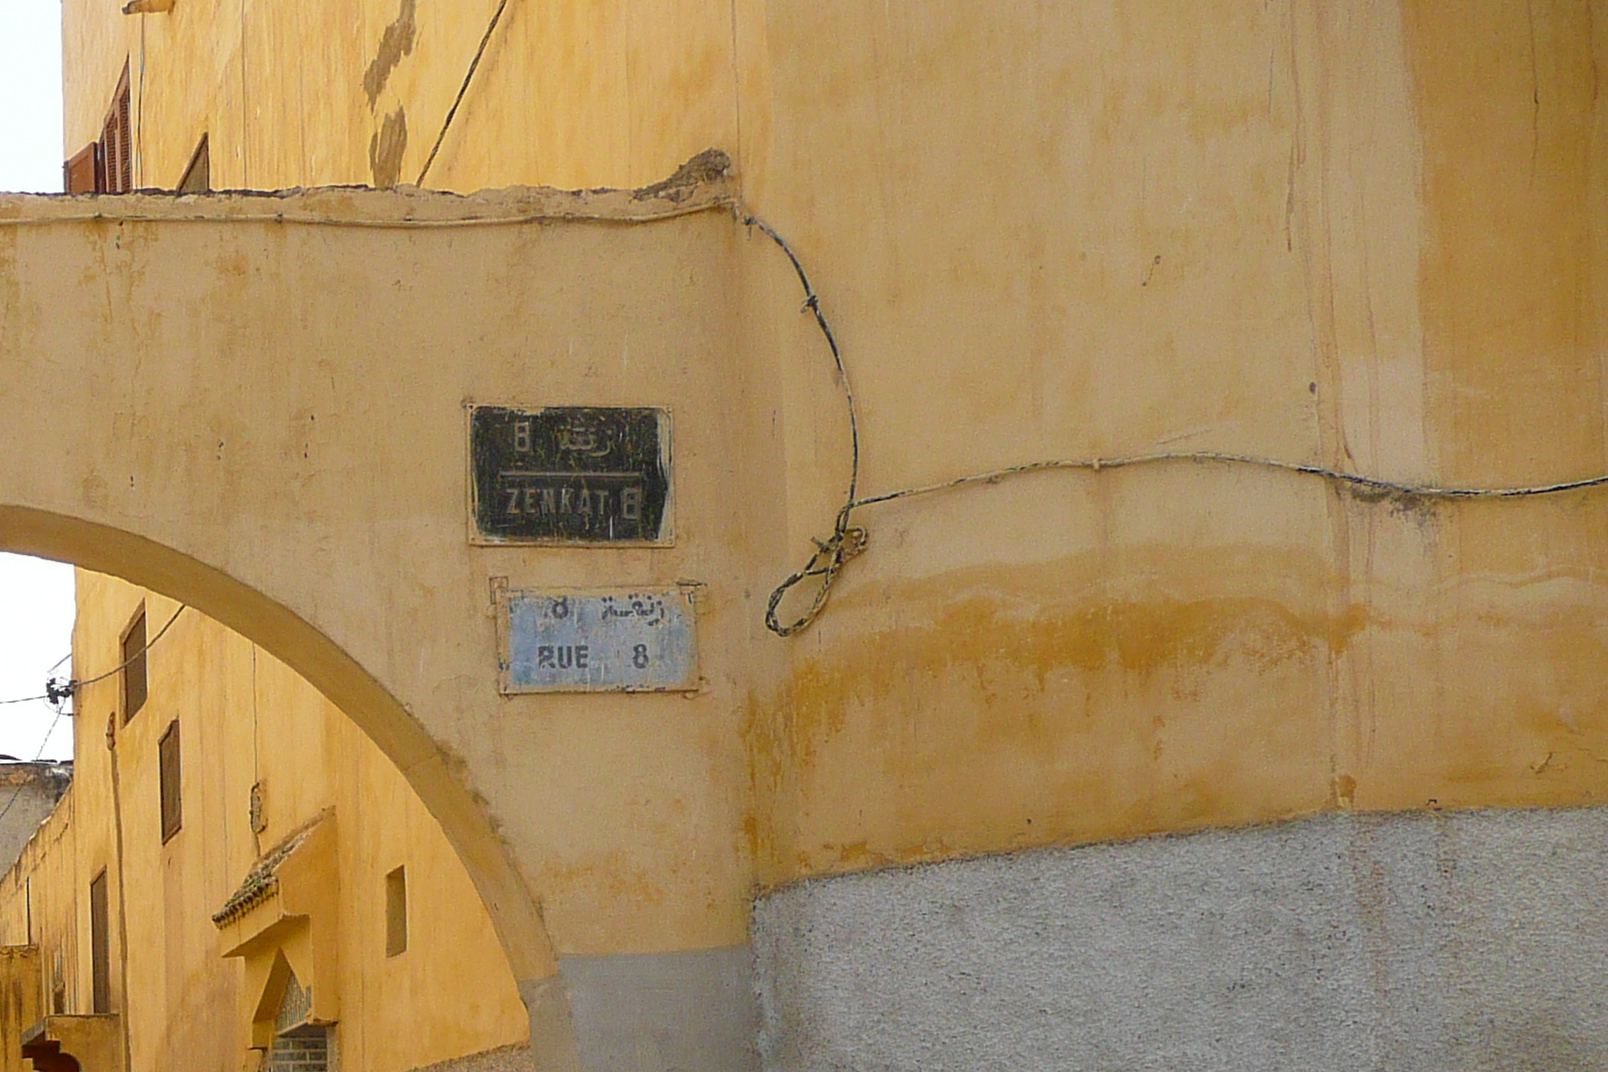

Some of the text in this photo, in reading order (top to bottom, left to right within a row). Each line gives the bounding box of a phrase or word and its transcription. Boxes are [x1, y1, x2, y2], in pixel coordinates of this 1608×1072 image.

[514, 421, 531, 453] 8
[505, 486, 643, 520] ZENKAT 8
[537, 642, 650, 670] RUE 8
